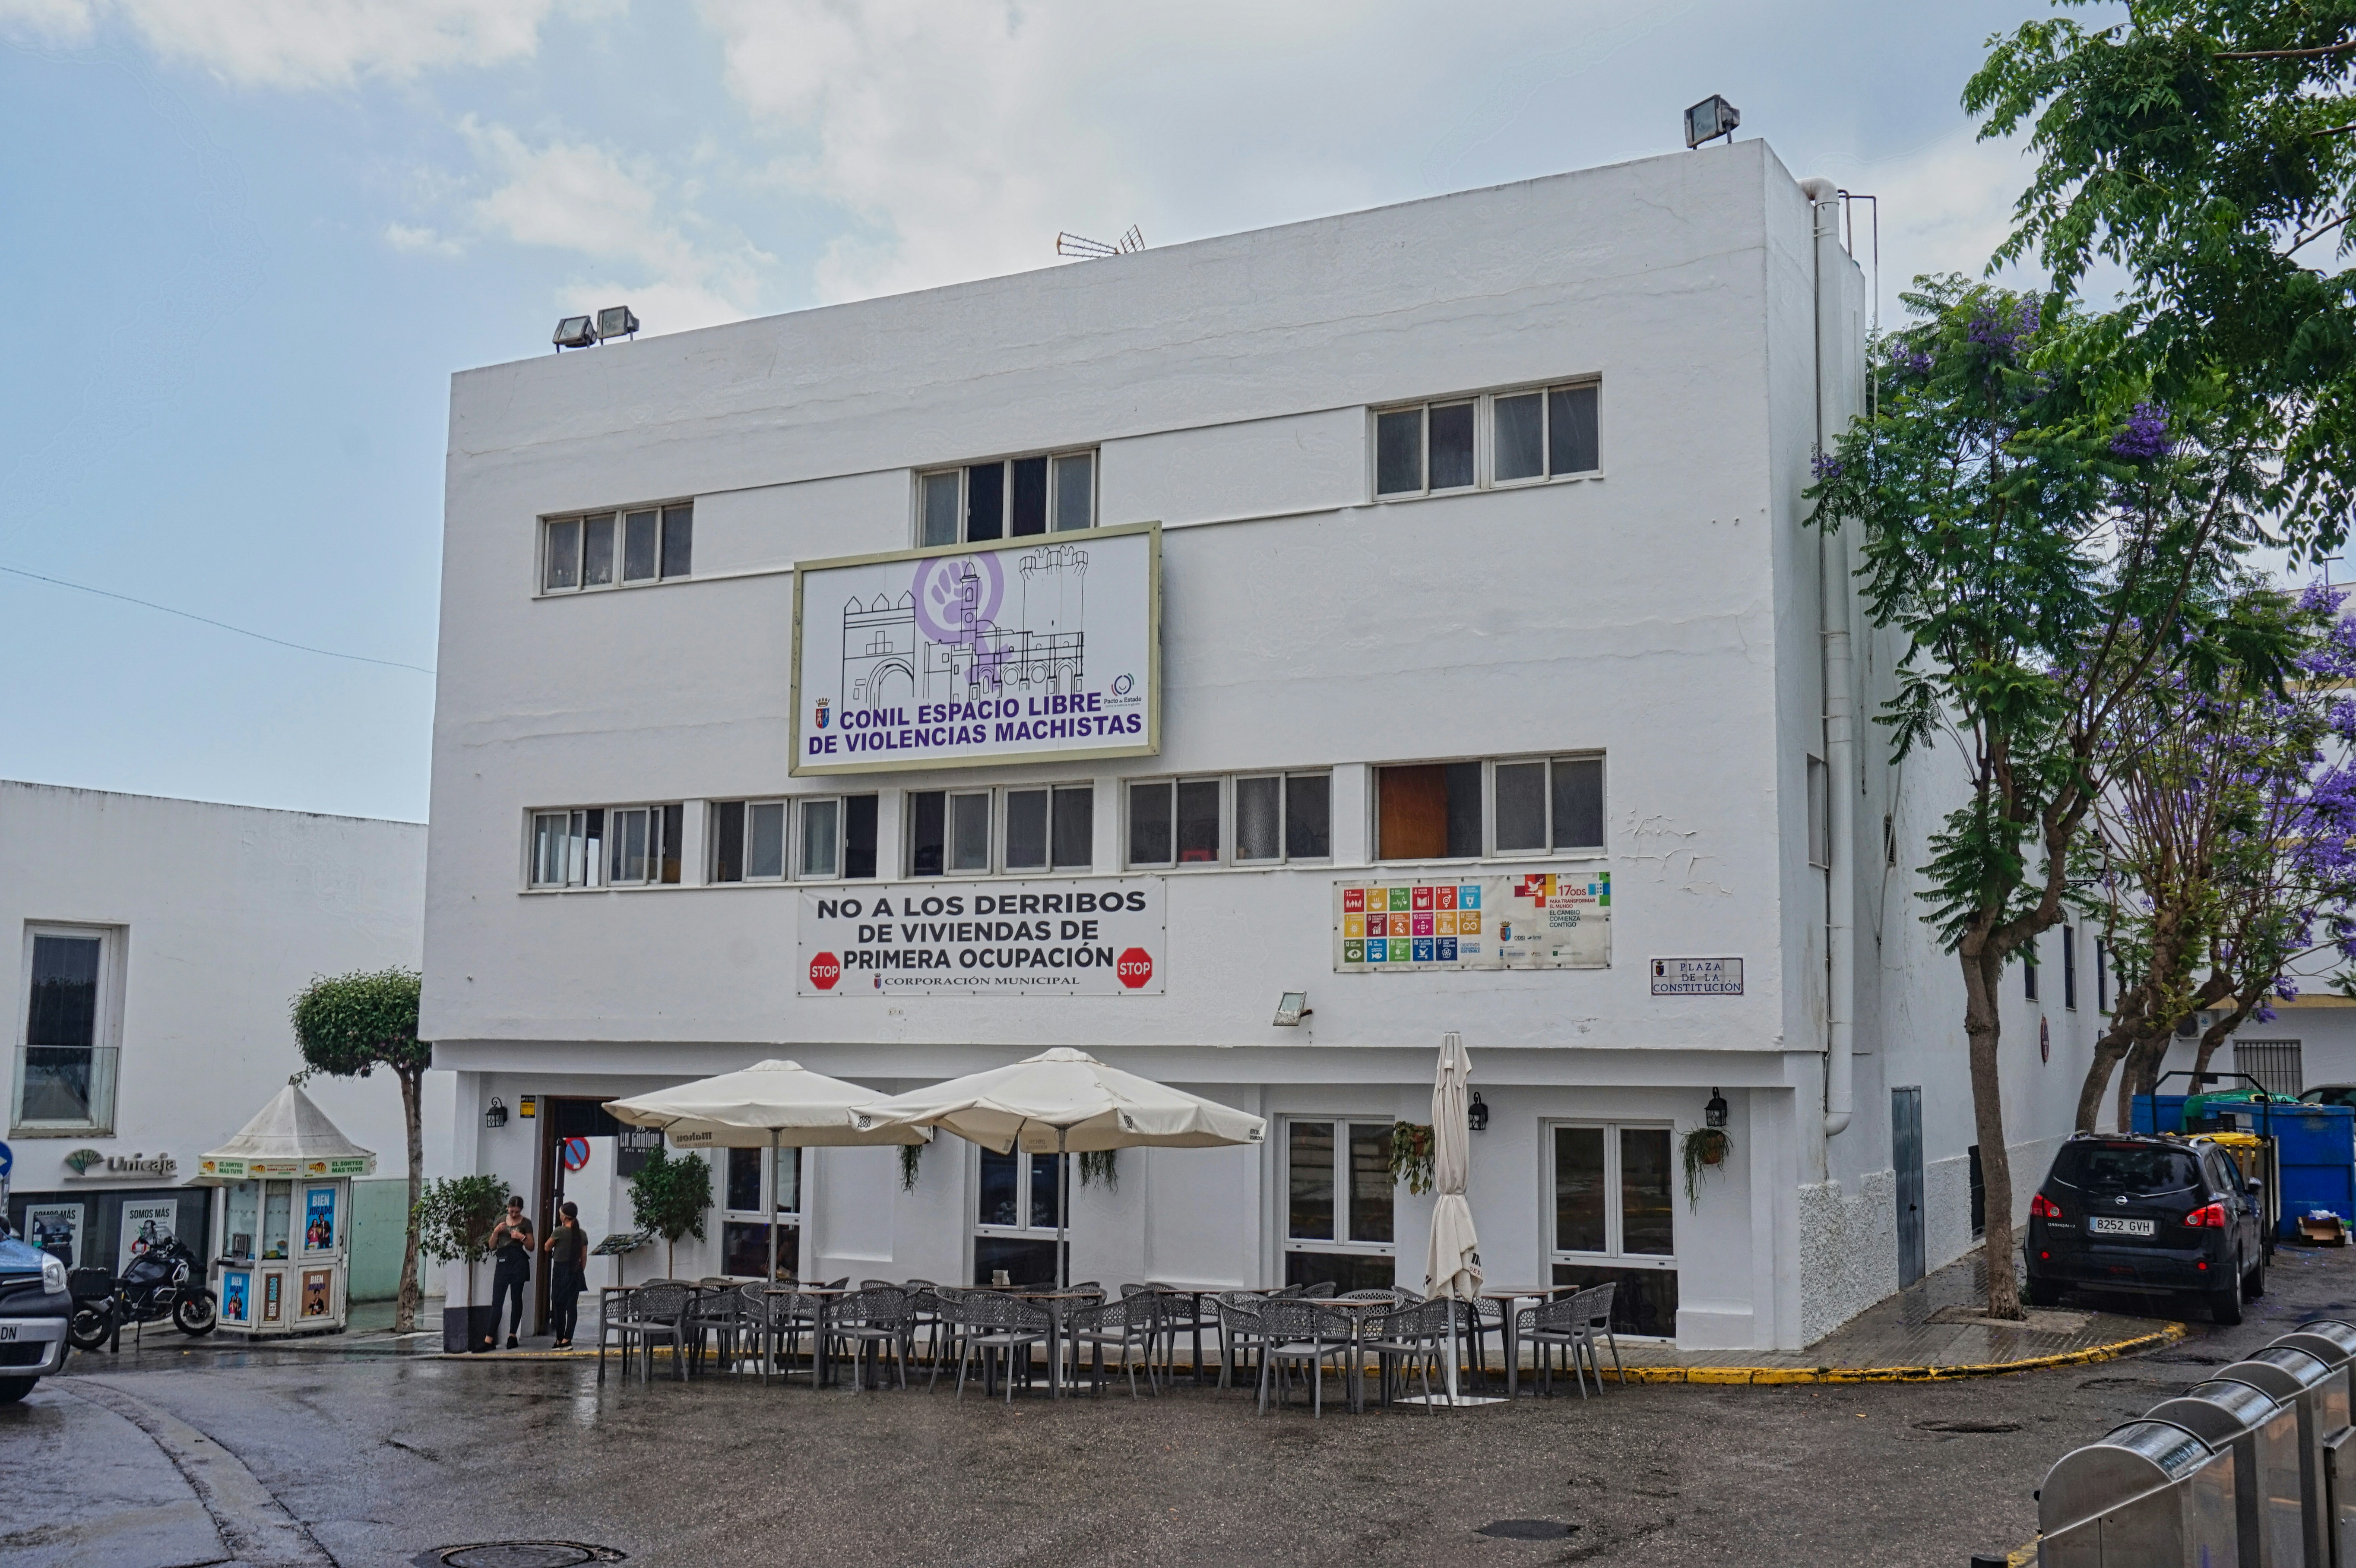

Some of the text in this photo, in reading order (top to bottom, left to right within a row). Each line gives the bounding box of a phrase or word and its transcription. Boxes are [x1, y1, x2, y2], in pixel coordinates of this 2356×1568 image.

[840, 692, 1101, 730] CONIL ESPACIO LIBRE
[809, 714, 1141, 755] DE VIOLENCIAS MACHISTAS
[818, 891, 1146, 919] NO A LOS DERRIBOS
[858, 920, 1099, 943] DE VIVIENDAS DE
[843, 941, 1114, 970] PRIMERA OCUPACIÓN
[811, 965, 838, 978] STOP
[1119, 962, 1150, 975] STOP
[1680, 963, 1722, 971] PLAZA
[884, 975, 990, 986] CORPORACIÓN
[1653, 980, 1741, 992] CONSTITUCIÓN
[108, 1152, 177, 1175] Unicaja
[312, 1195, 329, 1207] BIEN
[130, 1207, 169, 1219] SOMOS MÁS
[309, 1205, 332, 1216] JUGADO
[2097, 1219, 2150, 1232] 8252 GVH
[310, 1274, 323, 1284] BIEN
[268, 1302, 276, 1317] BIEN
